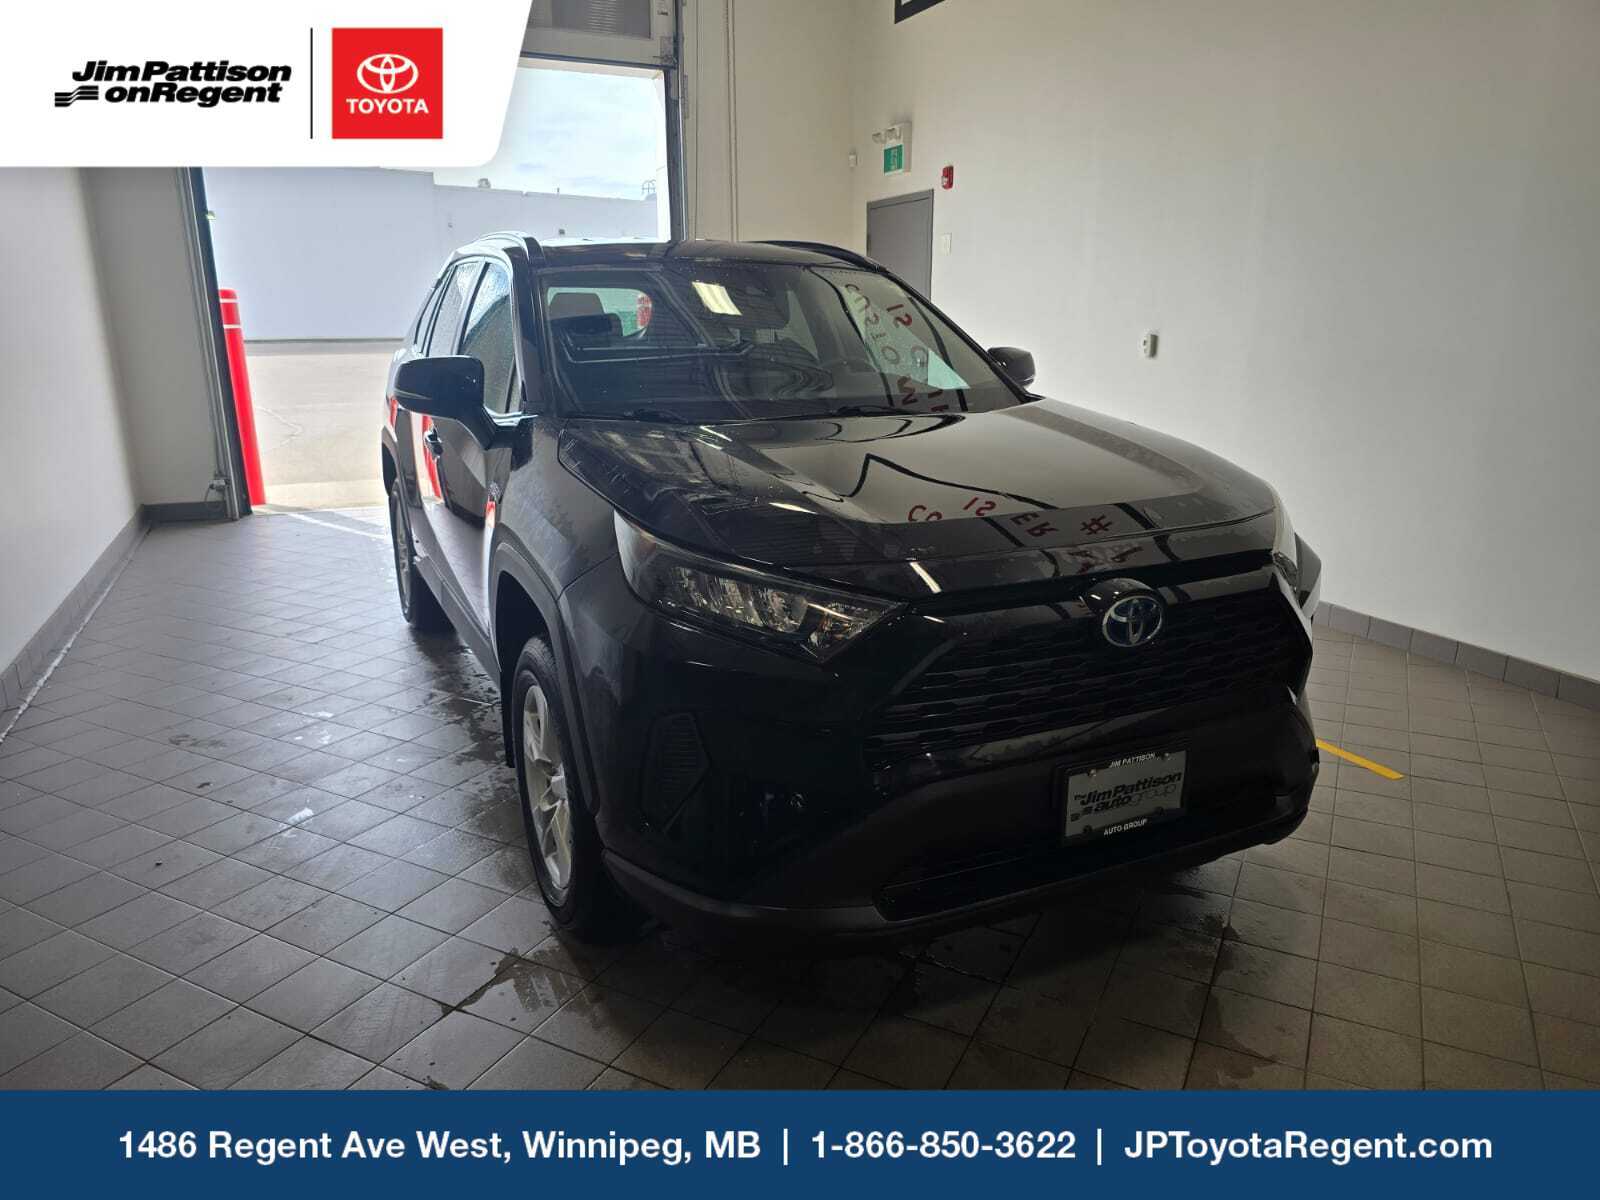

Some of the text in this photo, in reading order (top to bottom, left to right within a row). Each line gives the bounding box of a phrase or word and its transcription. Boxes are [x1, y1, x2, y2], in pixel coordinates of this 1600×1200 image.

[1109, 752, 1156, 769] JIM PATTISON
[1103, 818, 1148, 836] AUTO GROUP
